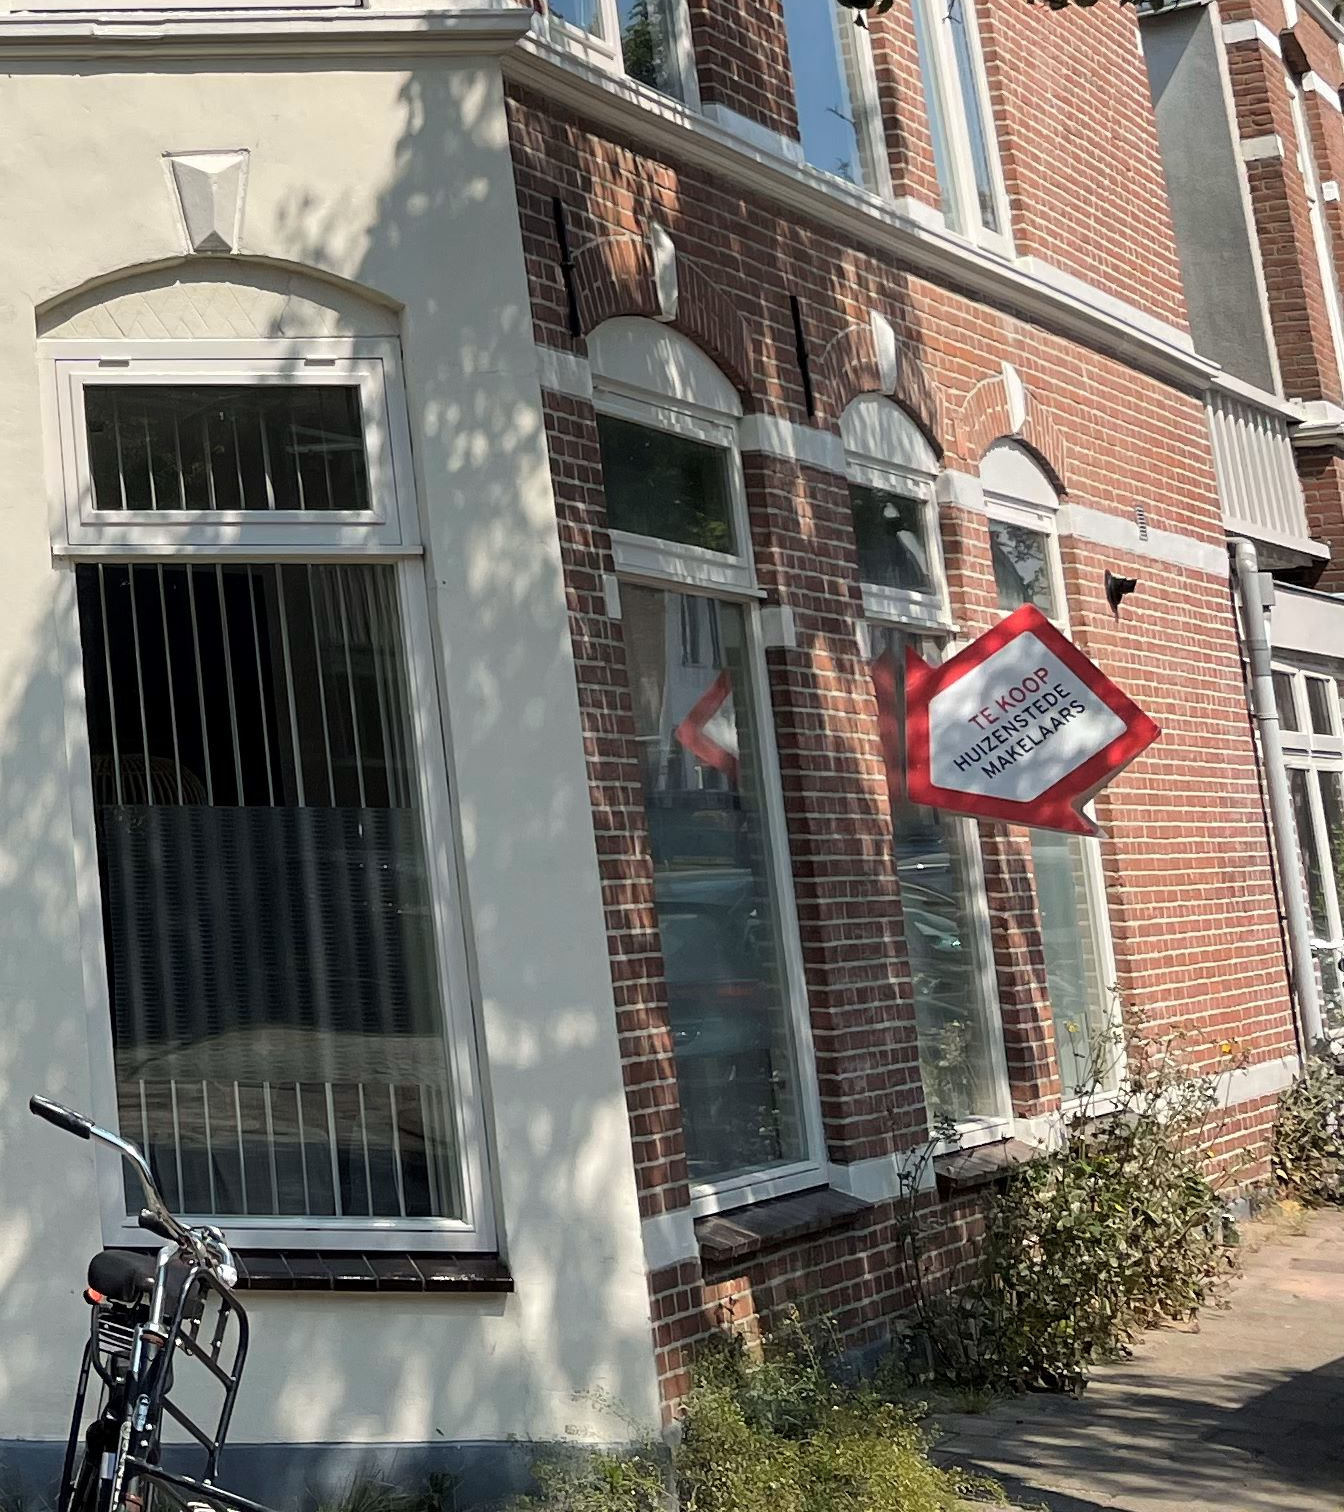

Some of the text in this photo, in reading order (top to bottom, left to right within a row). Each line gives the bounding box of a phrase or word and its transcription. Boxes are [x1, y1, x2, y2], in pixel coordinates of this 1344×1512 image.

[953, 683, 1071, 772] HUIZENSTEDE
[968, 667, 1049, 730] TE KOOP
[981, 700, 1086, 779] MAKELAARS
